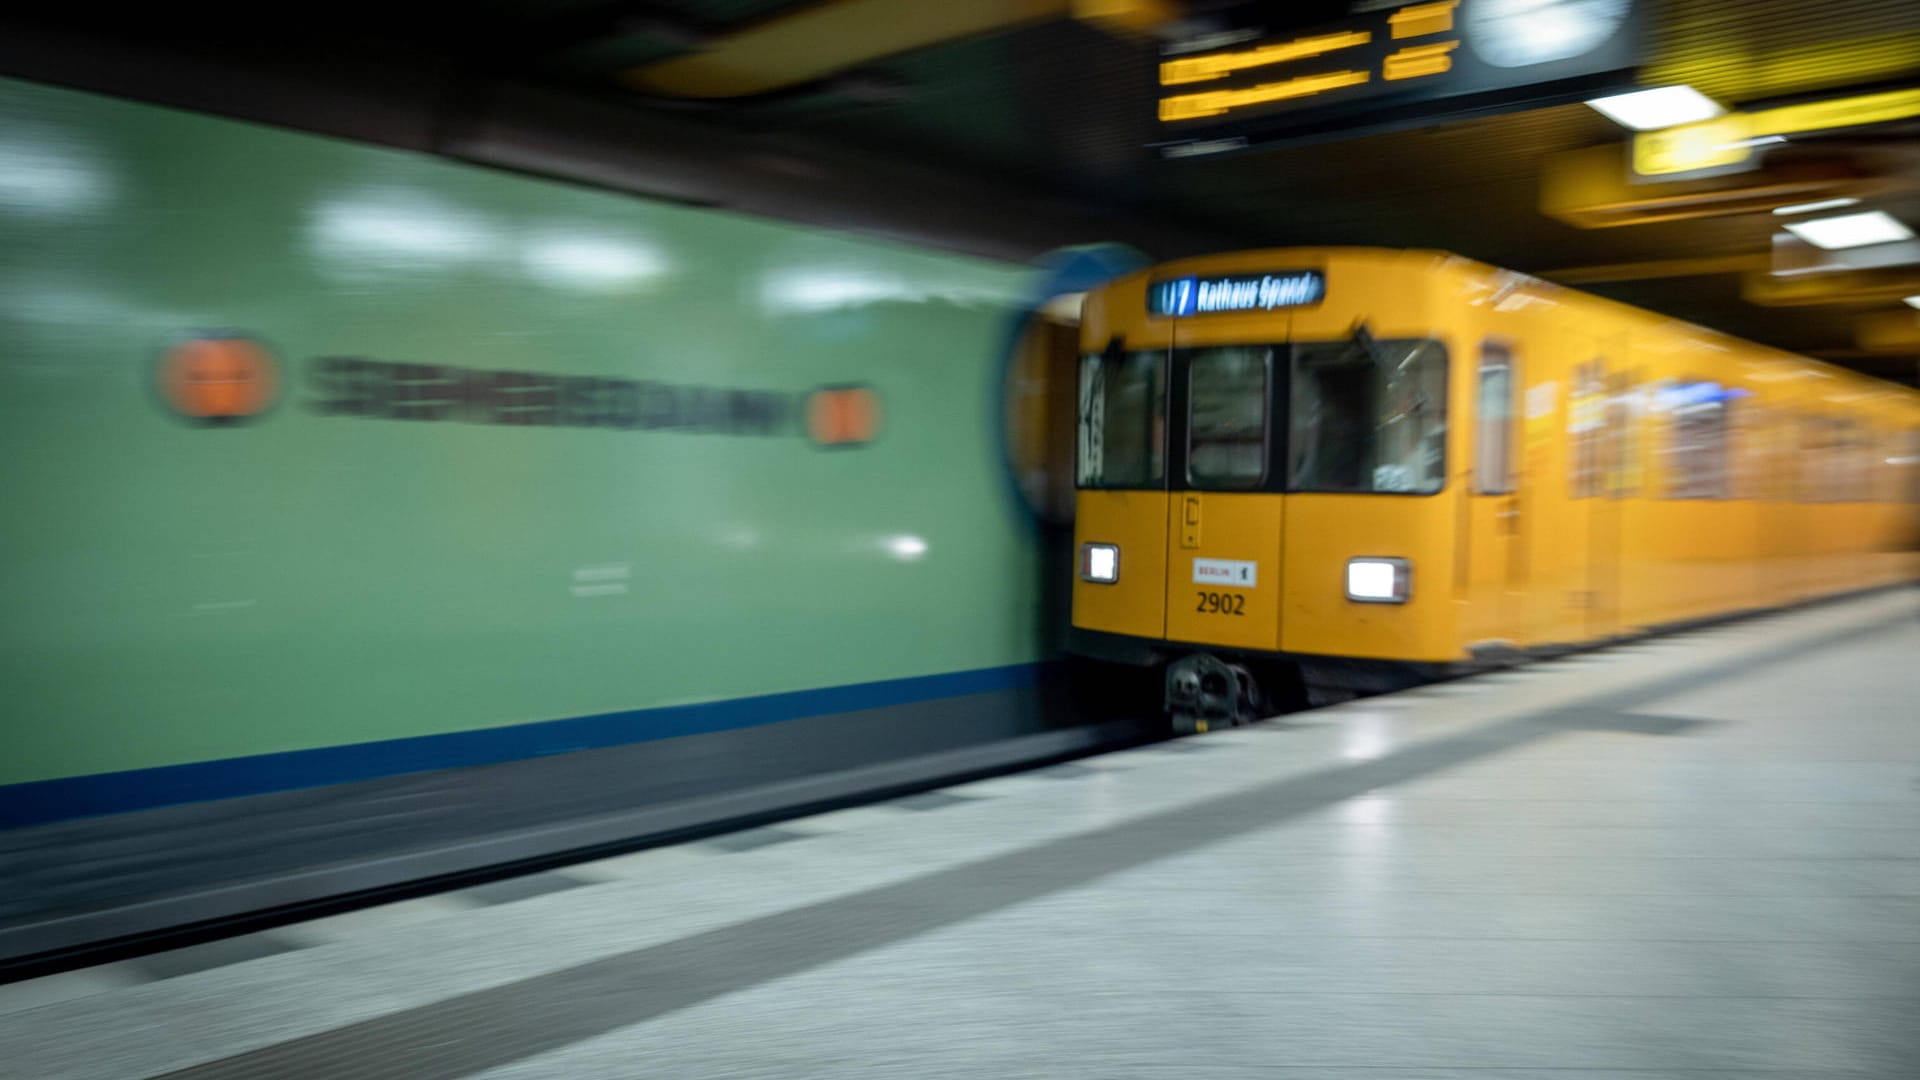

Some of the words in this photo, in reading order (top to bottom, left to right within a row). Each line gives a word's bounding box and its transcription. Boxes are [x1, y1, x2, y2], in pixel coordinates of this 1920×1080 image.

[1197, 278, 1258, 312] Rathaus
[1198, 566, 1231, 577] BERLIN
[1196, 592, 1245, 616] 2902
